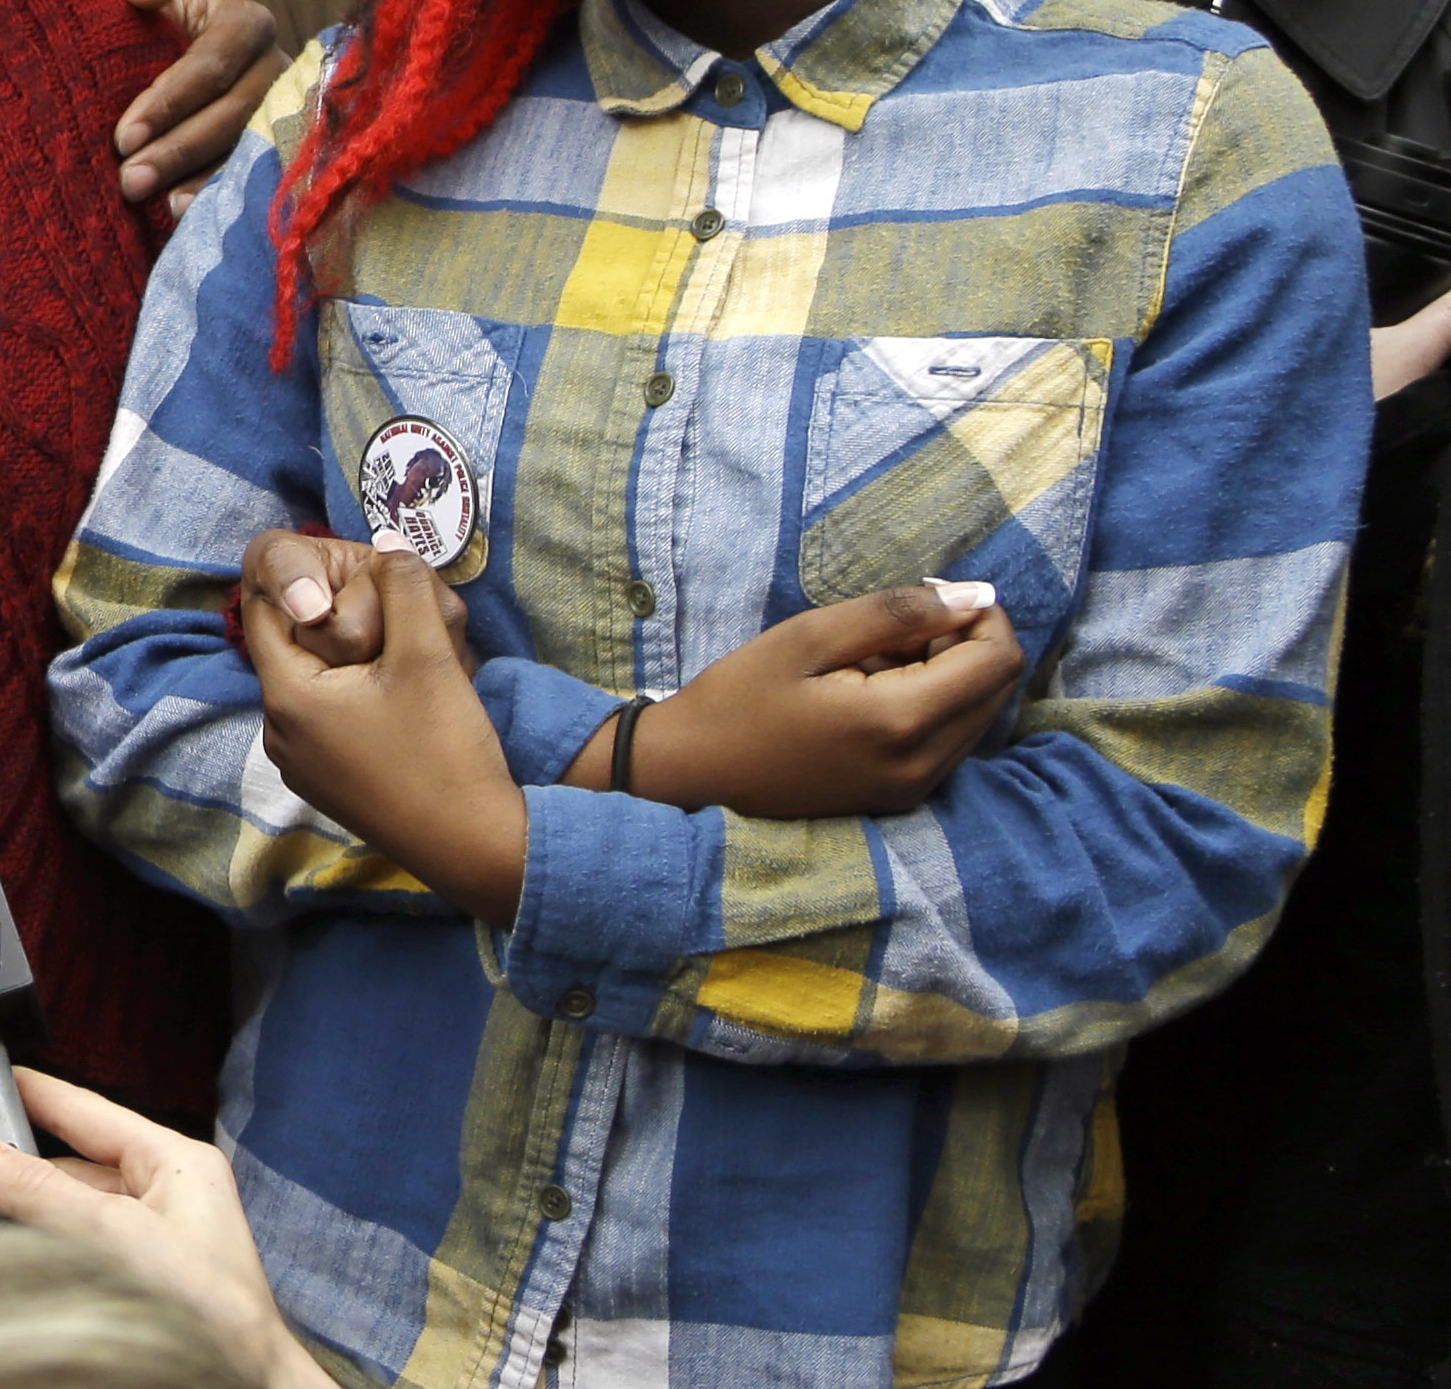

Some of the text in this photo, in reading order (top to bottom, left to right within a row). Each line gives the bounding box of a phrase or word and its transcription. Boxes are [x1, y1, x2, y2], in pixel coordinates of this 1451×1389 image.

[382, 452, 395, 480] 2017
[454, 464, 468, 493] POLICE
[405, 516, 429, 555] HAYES
[455, 496, 470, 541] BRUTALITY
